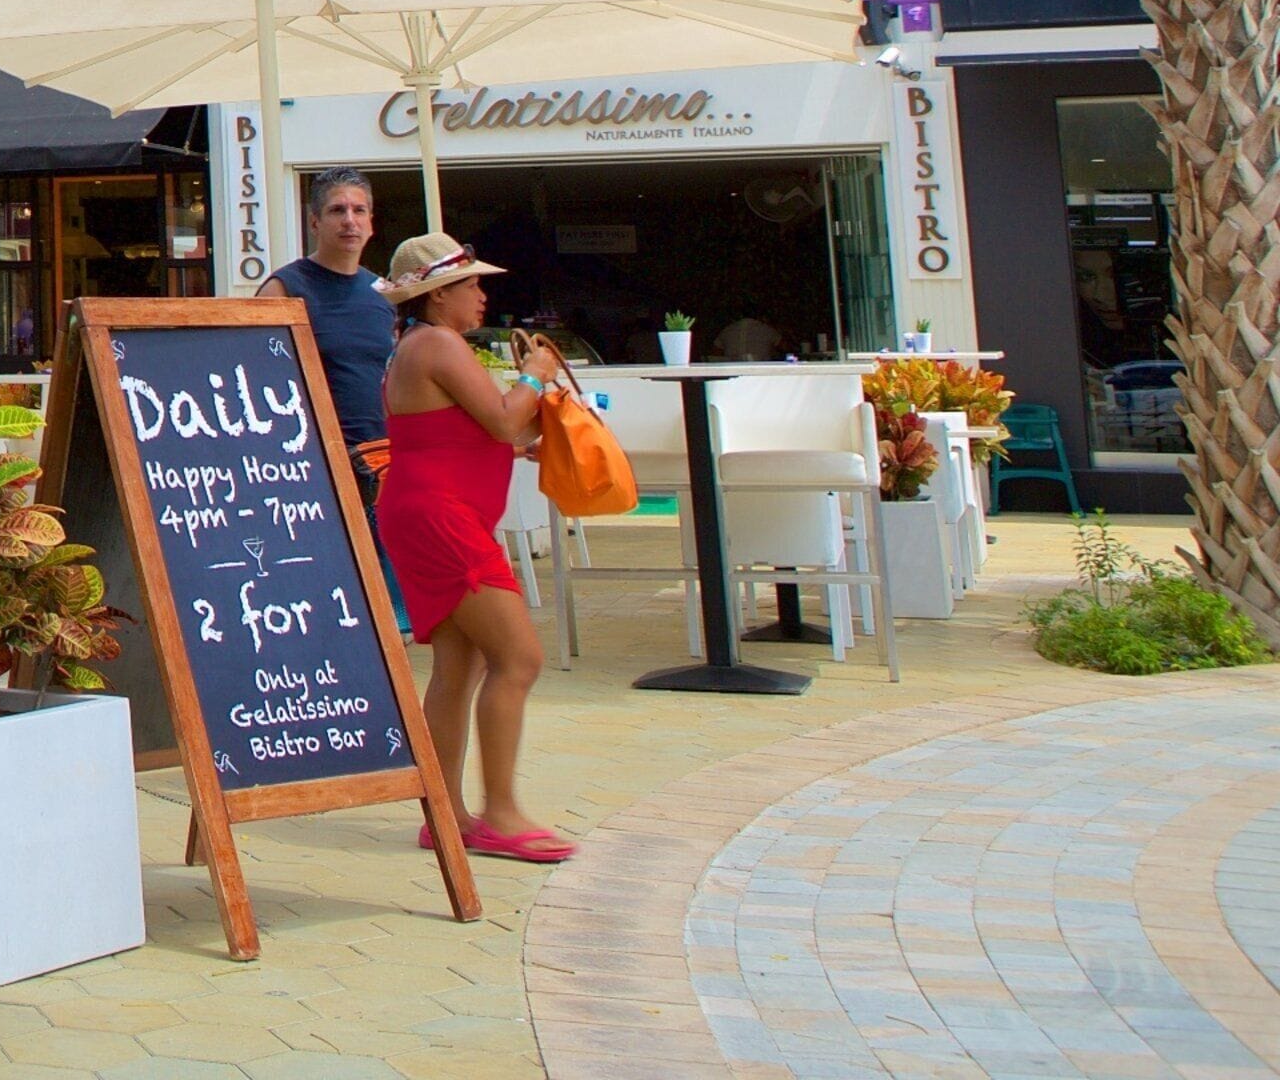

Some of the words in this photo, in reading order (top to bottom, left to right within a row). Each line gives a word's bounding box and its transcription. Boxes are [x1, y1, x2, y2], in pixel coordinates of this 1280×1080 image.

[236, 116, 265, 281] BISTRO
[907, 86, 950, 273] BISTRO
[119, 364, 309, 454] Daily
[145, 460, 236, 506] Happy
[242, 455, 311, 484] Hour
[159, 504, 229, 549] 4pm
[263, 497, 326, 541] 7pm
[192, 598, 224, 642] 2
[240, 580, 313, 654] for
[330, 586, 360, 627] 1
[255, 664, 309, 702] Only
[315, 659, 339, 685] at
[229, 695, 369, 728] Gelatissimo
[249, 730, 321, 761] Bistro
[326, 727, 367, 750] Bar
